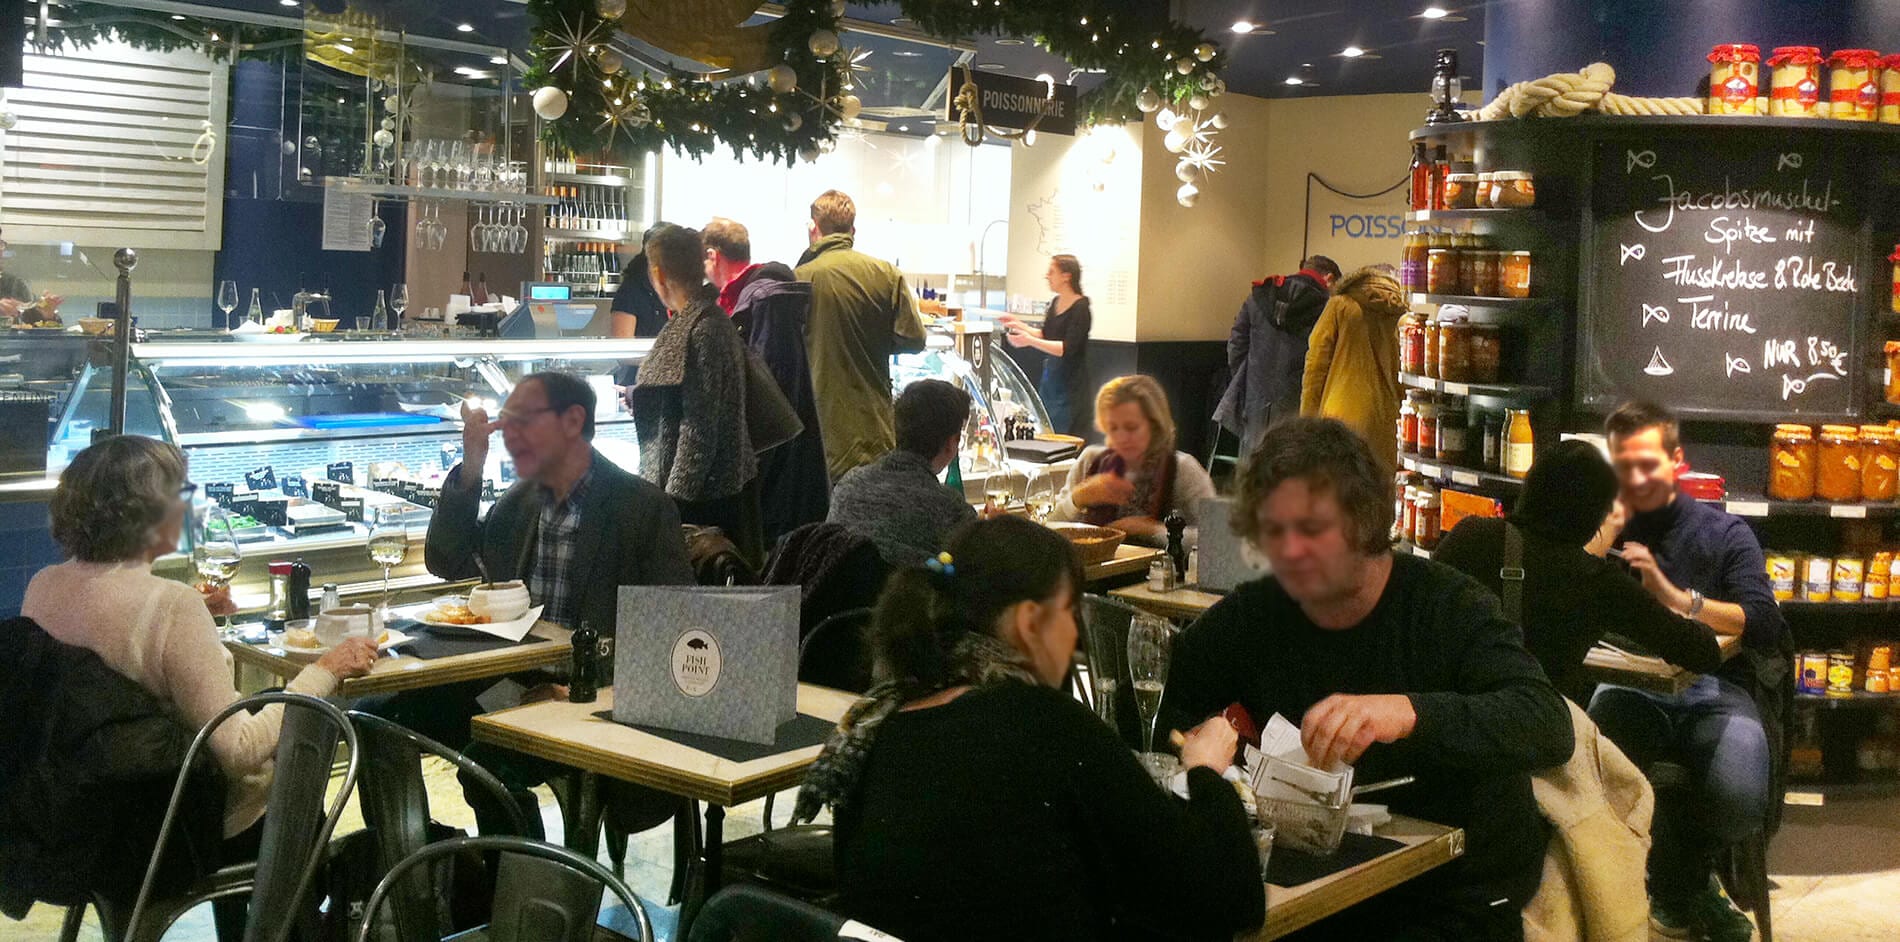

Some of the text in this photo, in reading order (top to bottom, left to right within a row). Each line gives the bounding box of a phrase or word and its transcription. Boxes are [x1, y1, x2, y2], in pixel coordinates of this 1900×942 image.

[1330, 213, 1441, 239] POISS
[1704, 216, 1815, 255] Spitze mit
[1774, 259, 1788, 290] &
[1787, 255, 1823, 290] Rote
[1677, 294, 1757, 335] Terrine
[1763, 338, 1801, 370] NUR
[682, 663, 710, 676] POINT
[686, 654, 707, 666] FISH
